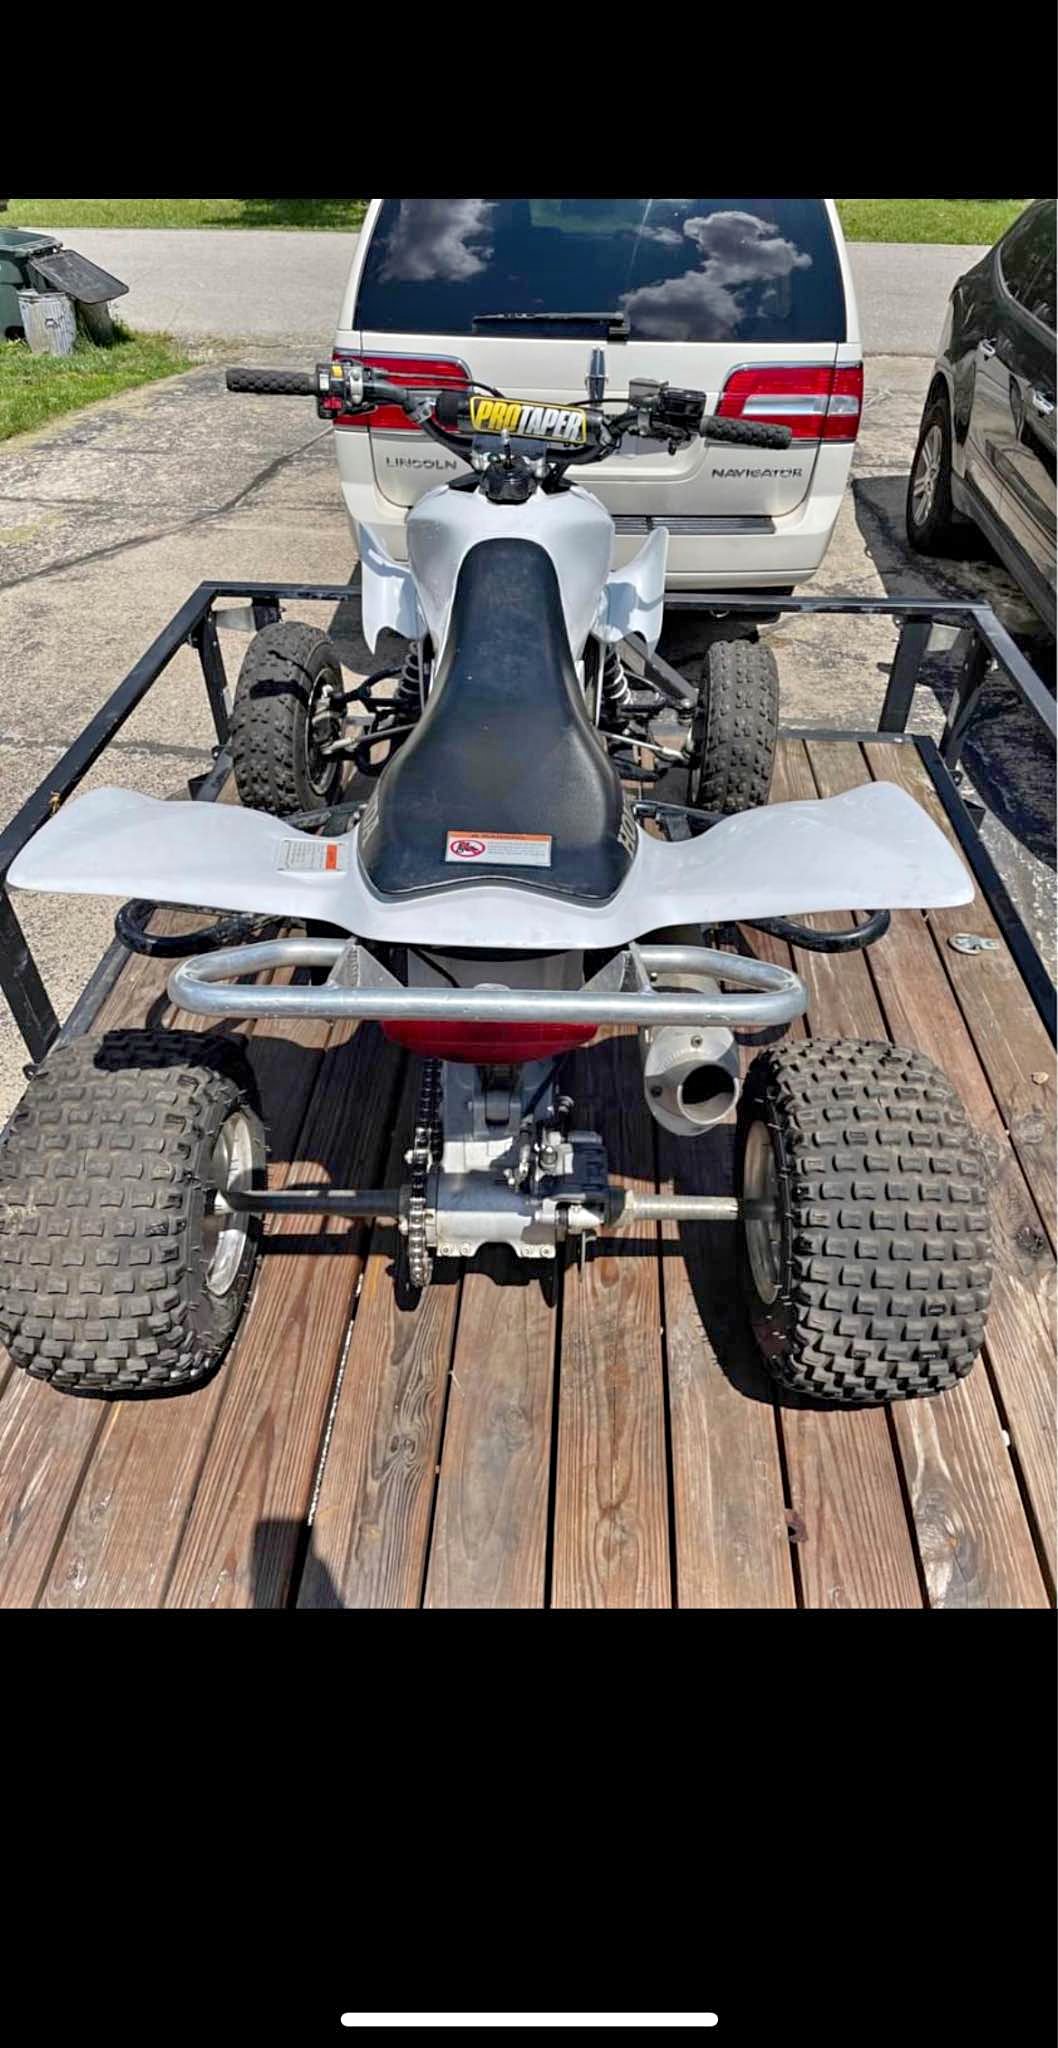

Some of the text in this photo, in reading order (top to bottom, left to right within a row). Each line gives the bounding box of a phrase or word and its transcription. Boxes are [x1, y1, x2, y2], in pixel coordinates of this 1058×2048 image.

[476, 400, 582, 441] PROTAPER
[386, 457, 457, 470] LINCOLN
[711, 468, 803, 478] NAVIGATOR
